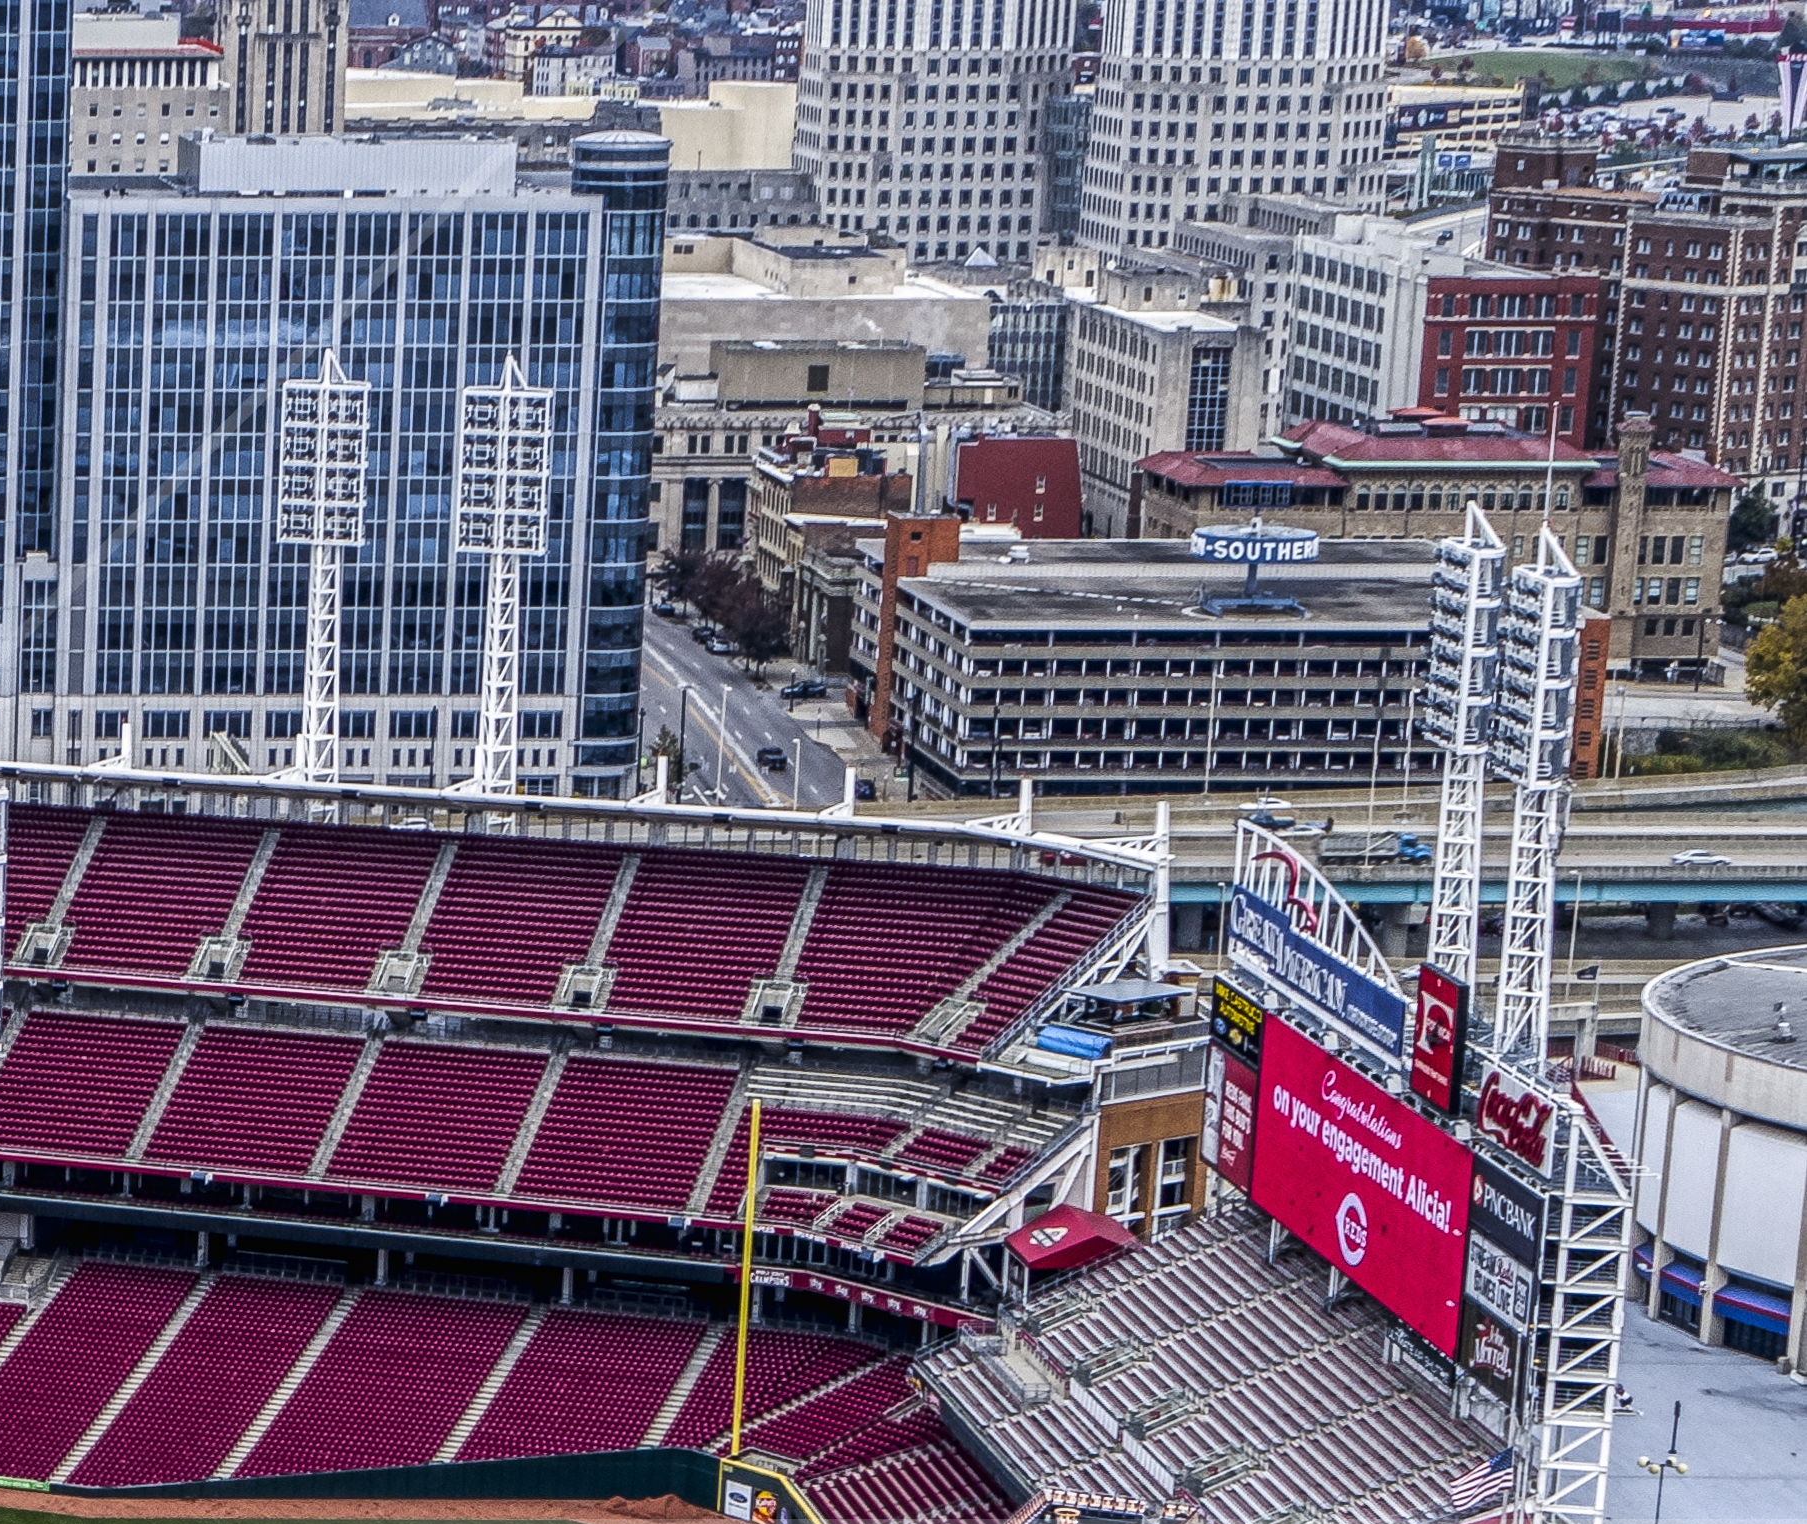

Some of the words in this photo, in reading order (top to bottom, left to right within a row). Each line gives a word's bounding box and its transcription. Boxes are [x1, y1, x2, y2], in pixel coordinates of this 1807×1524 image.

[1231, 894, 1278, 957] GREAT
[1322, 1070, 1402, 1149] Congratulations
[1273, 1085, 1289, 1115] on
[1290, 1096, 1321, 1137] your
[1322, 1120, 1404, 1199] engagement
[1405, 1175, 1451, 1233] Alicia!
[1344, 1217, 1367, 1248] REDS
